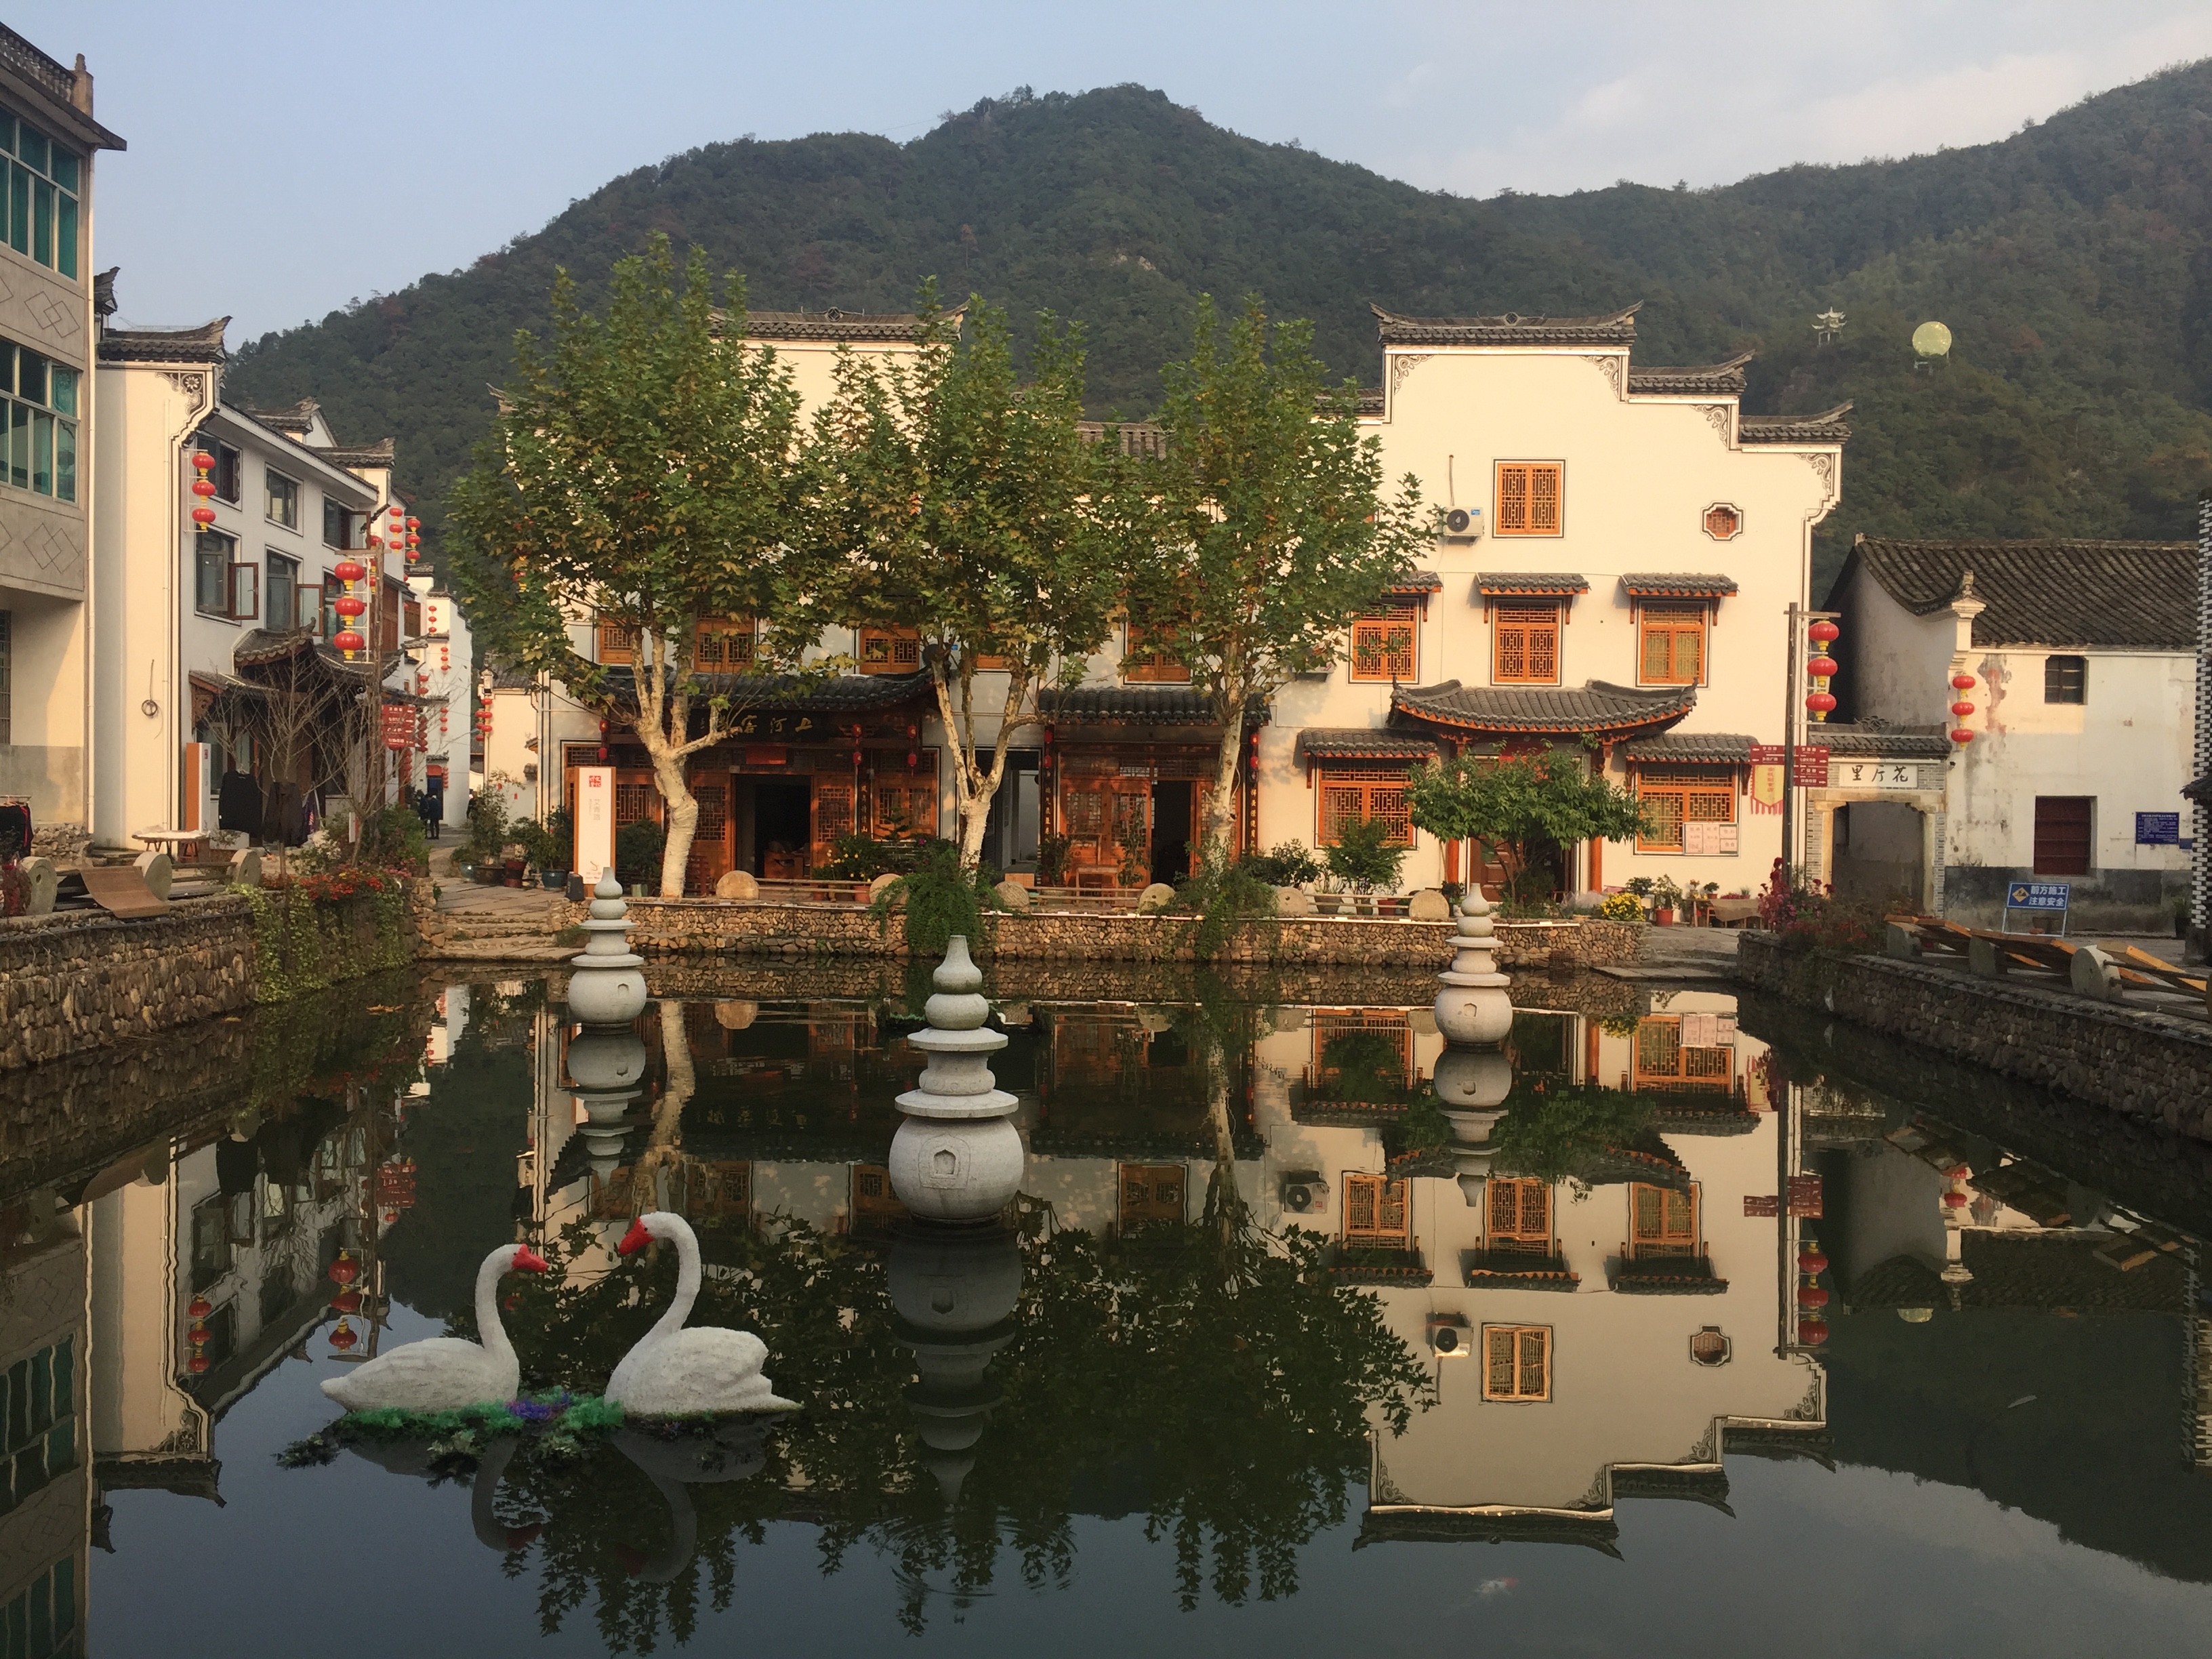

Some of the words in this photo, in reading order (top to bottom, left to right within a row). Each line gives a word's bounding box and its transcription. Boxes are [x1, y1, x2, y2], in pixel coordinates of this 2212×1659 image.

[2030, 885, 2066, 895] 前方施工
[2028, 897, 2065, 907] 注意安全
